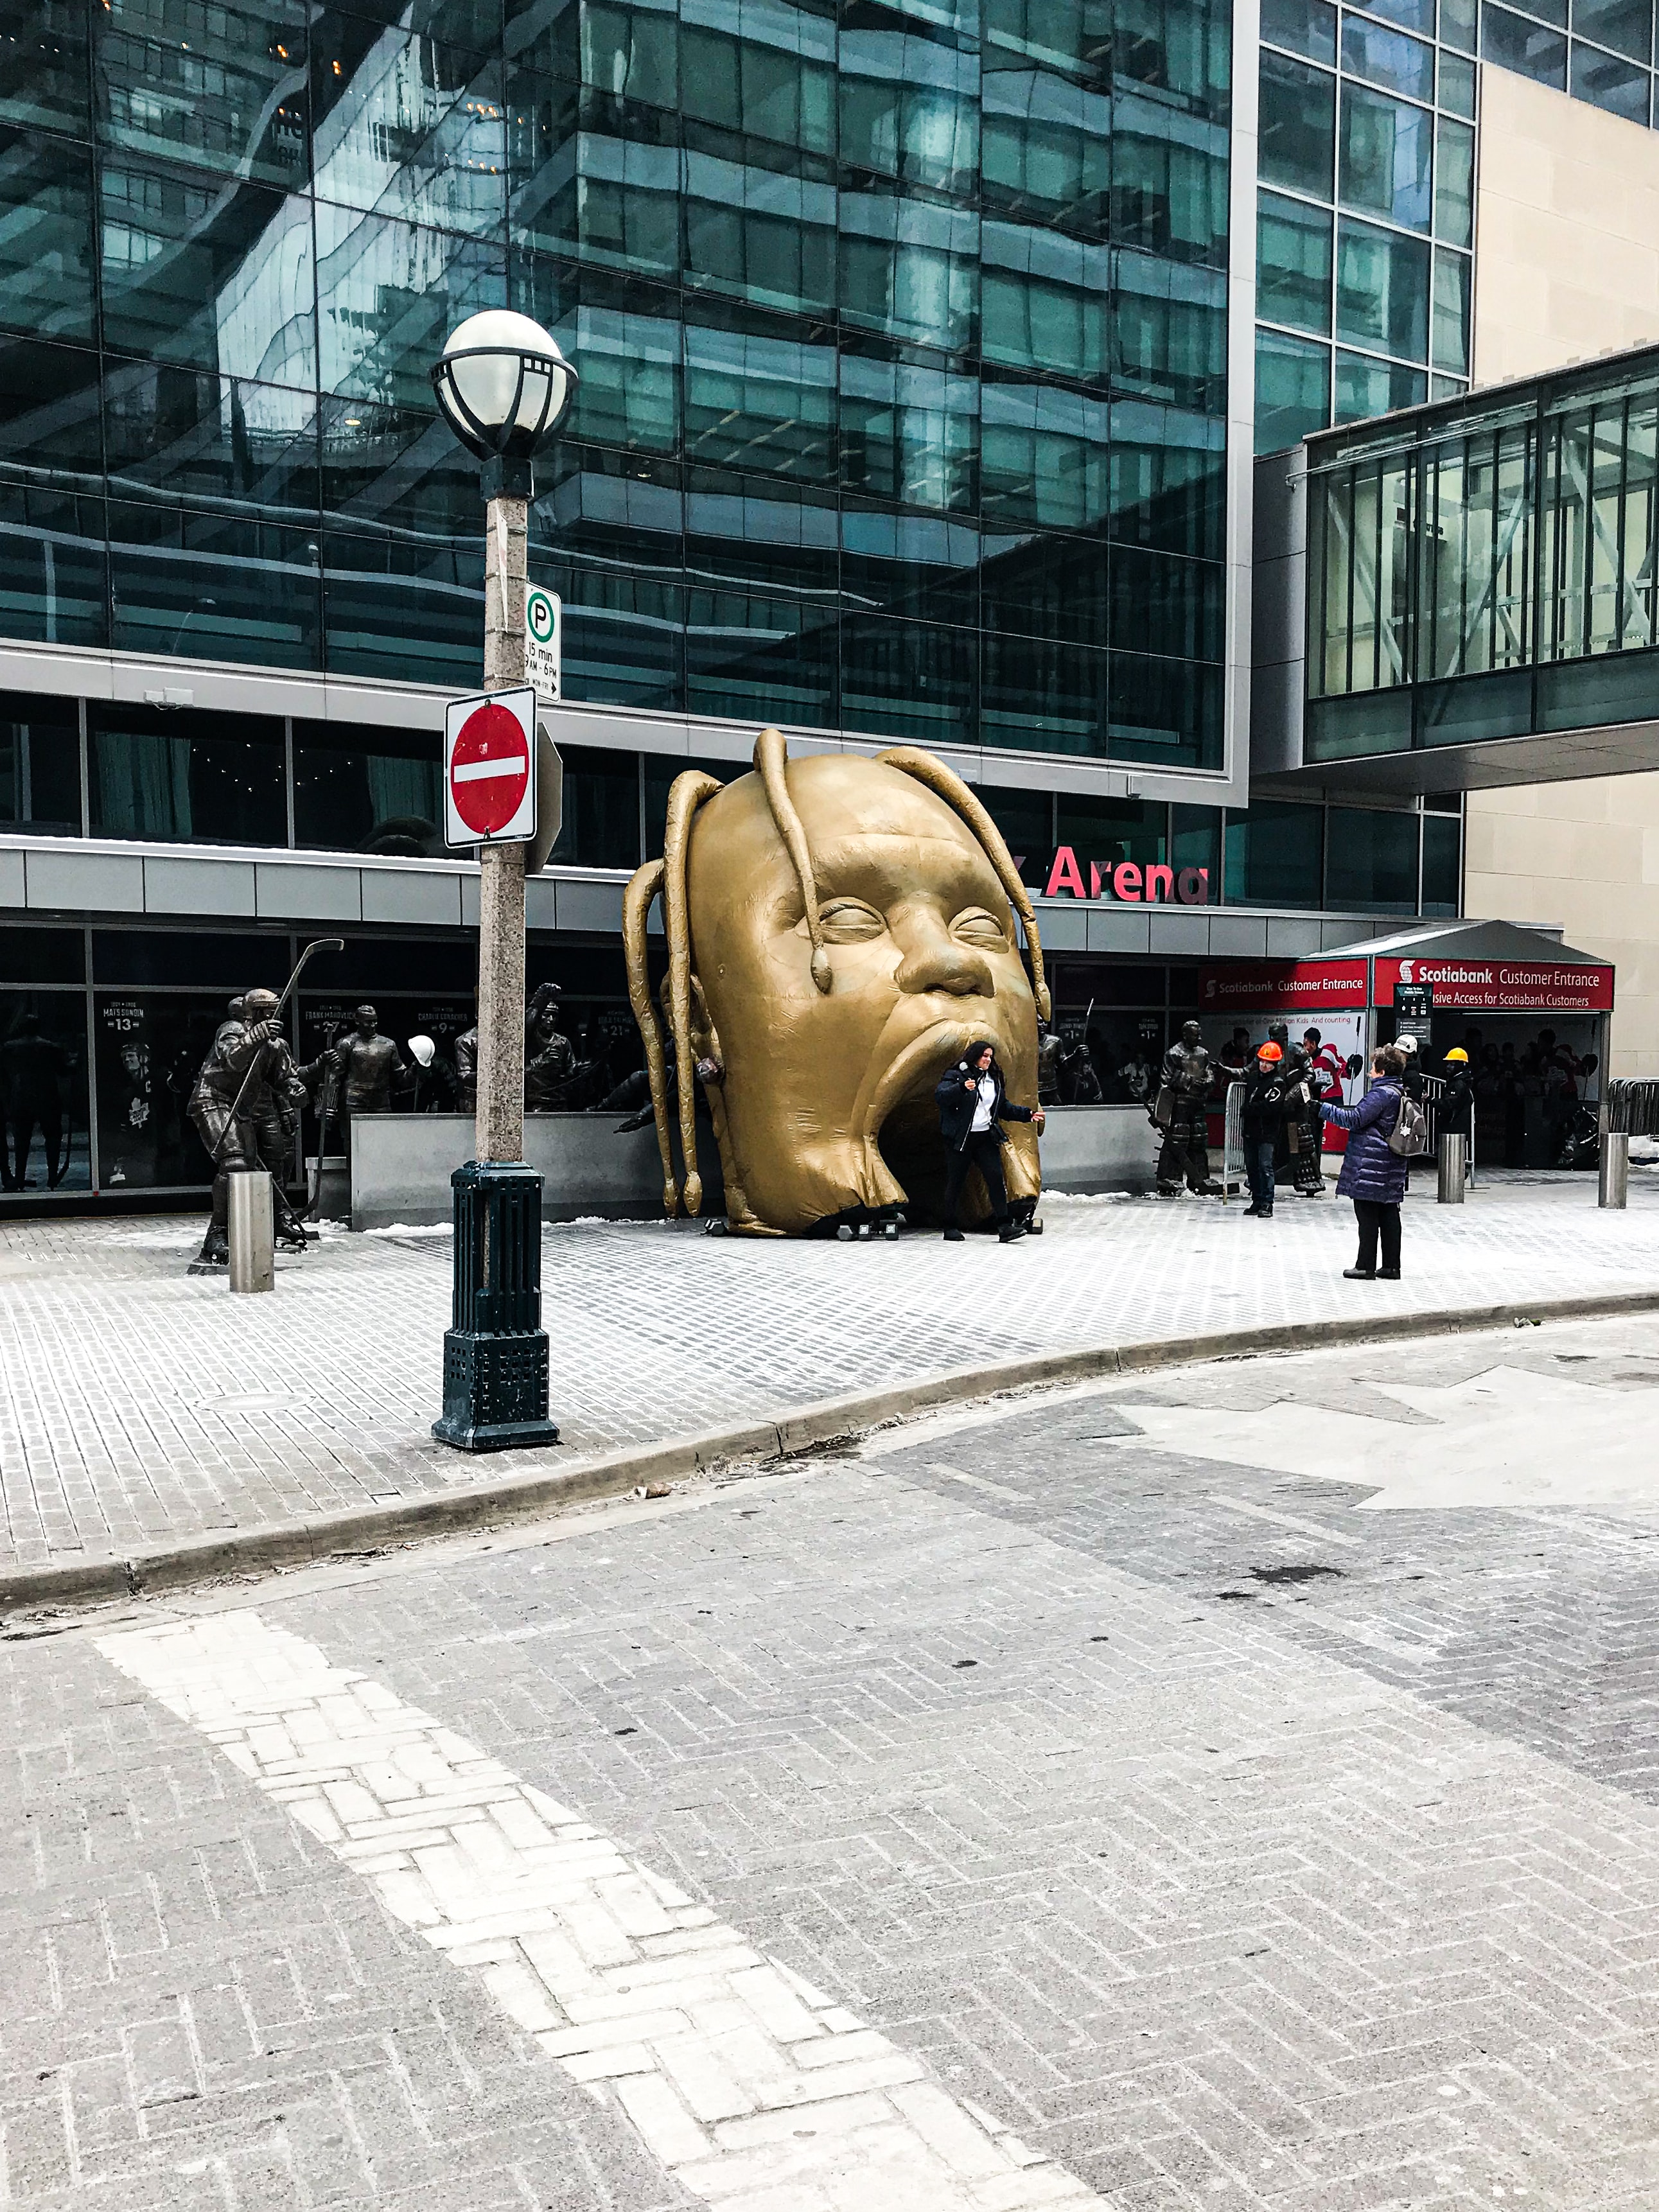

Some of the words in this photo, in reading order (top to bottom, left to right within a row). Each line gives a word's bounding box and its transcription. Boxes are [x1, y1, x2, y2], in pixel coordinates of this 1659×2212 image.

[535, 602, 547, 629] P
[529, 642, 536, 656] 15
[538, 648, 552, 663] min
[1045, 846, 1208, 905] Arena
[1220, 980, 1273, 994] Scotiabank
[1278, 980, 1321, 991] Customer
[1322, 978, 1363, 990] Entrance
[1419, 965, 1493, 983] Scotiabank
[1500, 969, 1552, 985] Customer
[1554, 970, 1600, 987] Entrance
[1453, 992, 1483, 1004] Access
[1484, 992, 1497, 1005] for
[1499, 992, 1545, 1006] Scotiabank
[1547, 994, 1589, 1006] Customers
[116, 1018, 131, 1031] 13
